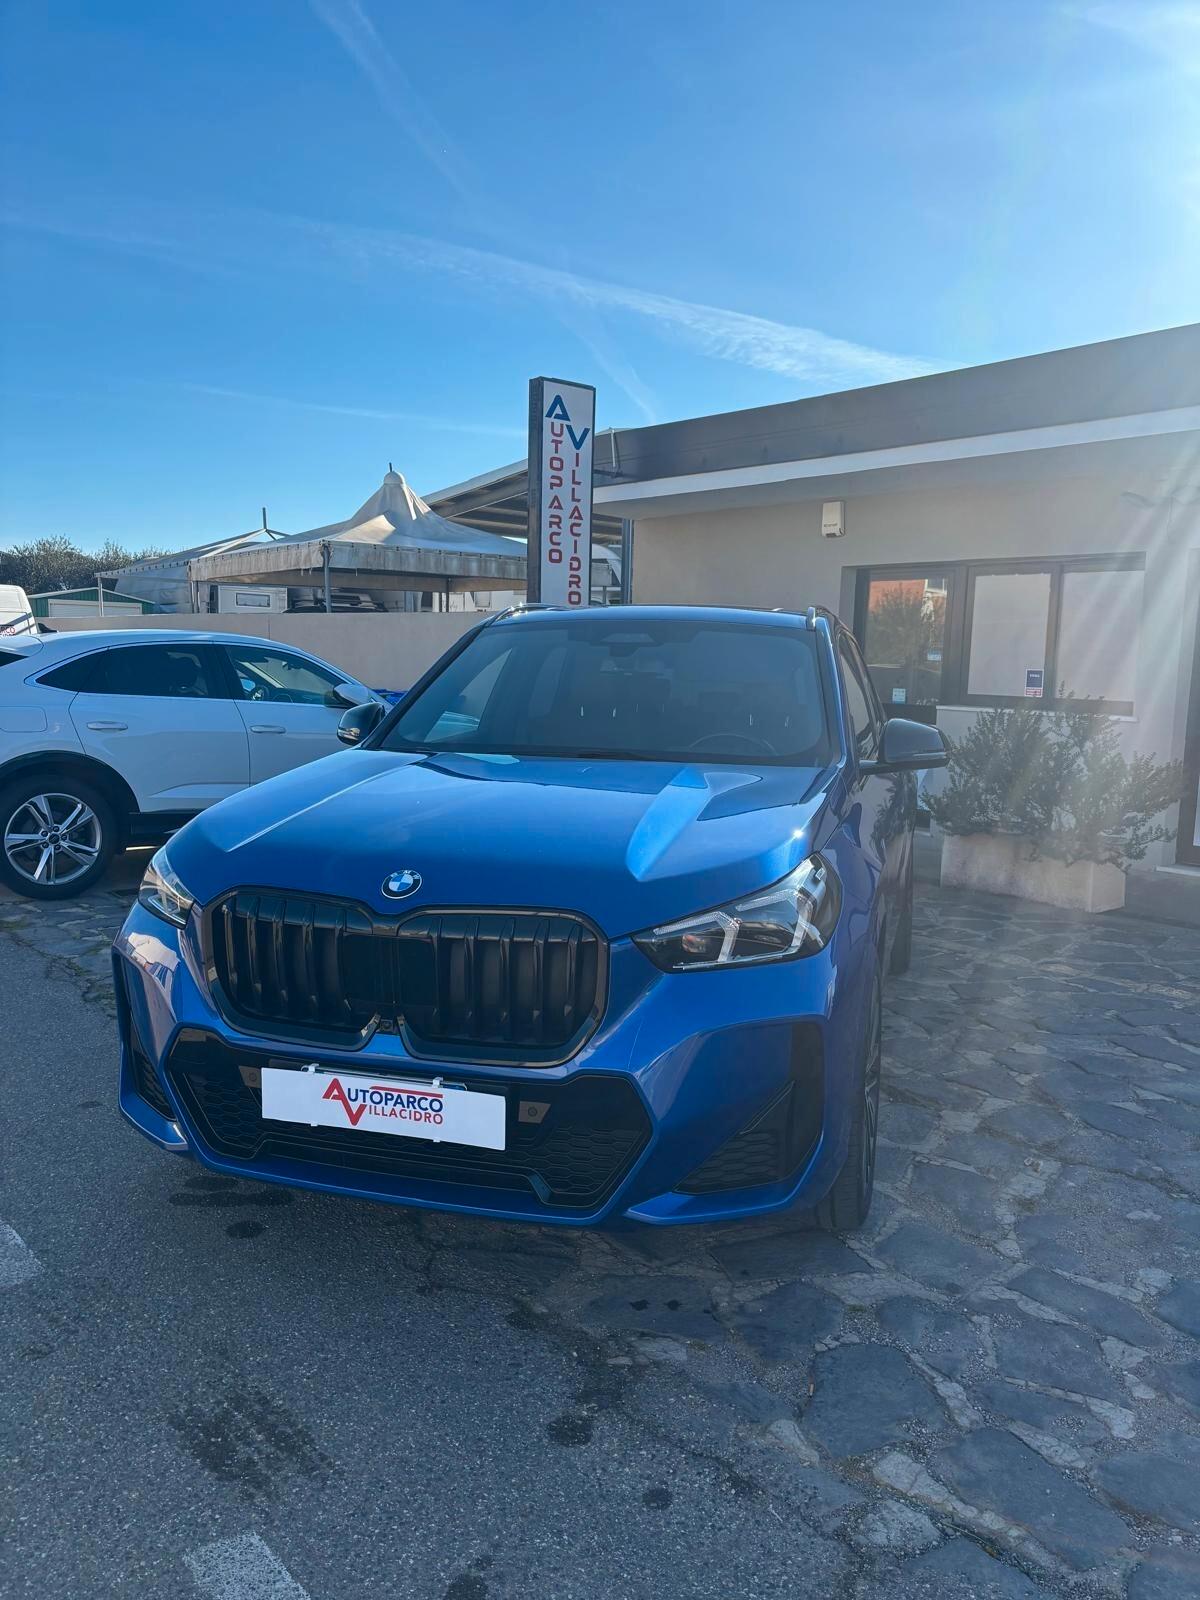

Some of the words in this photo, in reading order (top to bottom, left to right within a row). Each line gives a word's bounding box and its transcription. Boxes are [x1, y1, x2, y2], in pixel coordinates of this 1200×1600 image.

[545, 394, 571, 564] AUTOPARCO
[566, 424, 590, 605] VILLACIDRO
[322, 1078, 443, 1112] AUTOPARCO
[343, 1102, 443, 1126] VILLACIDRO
